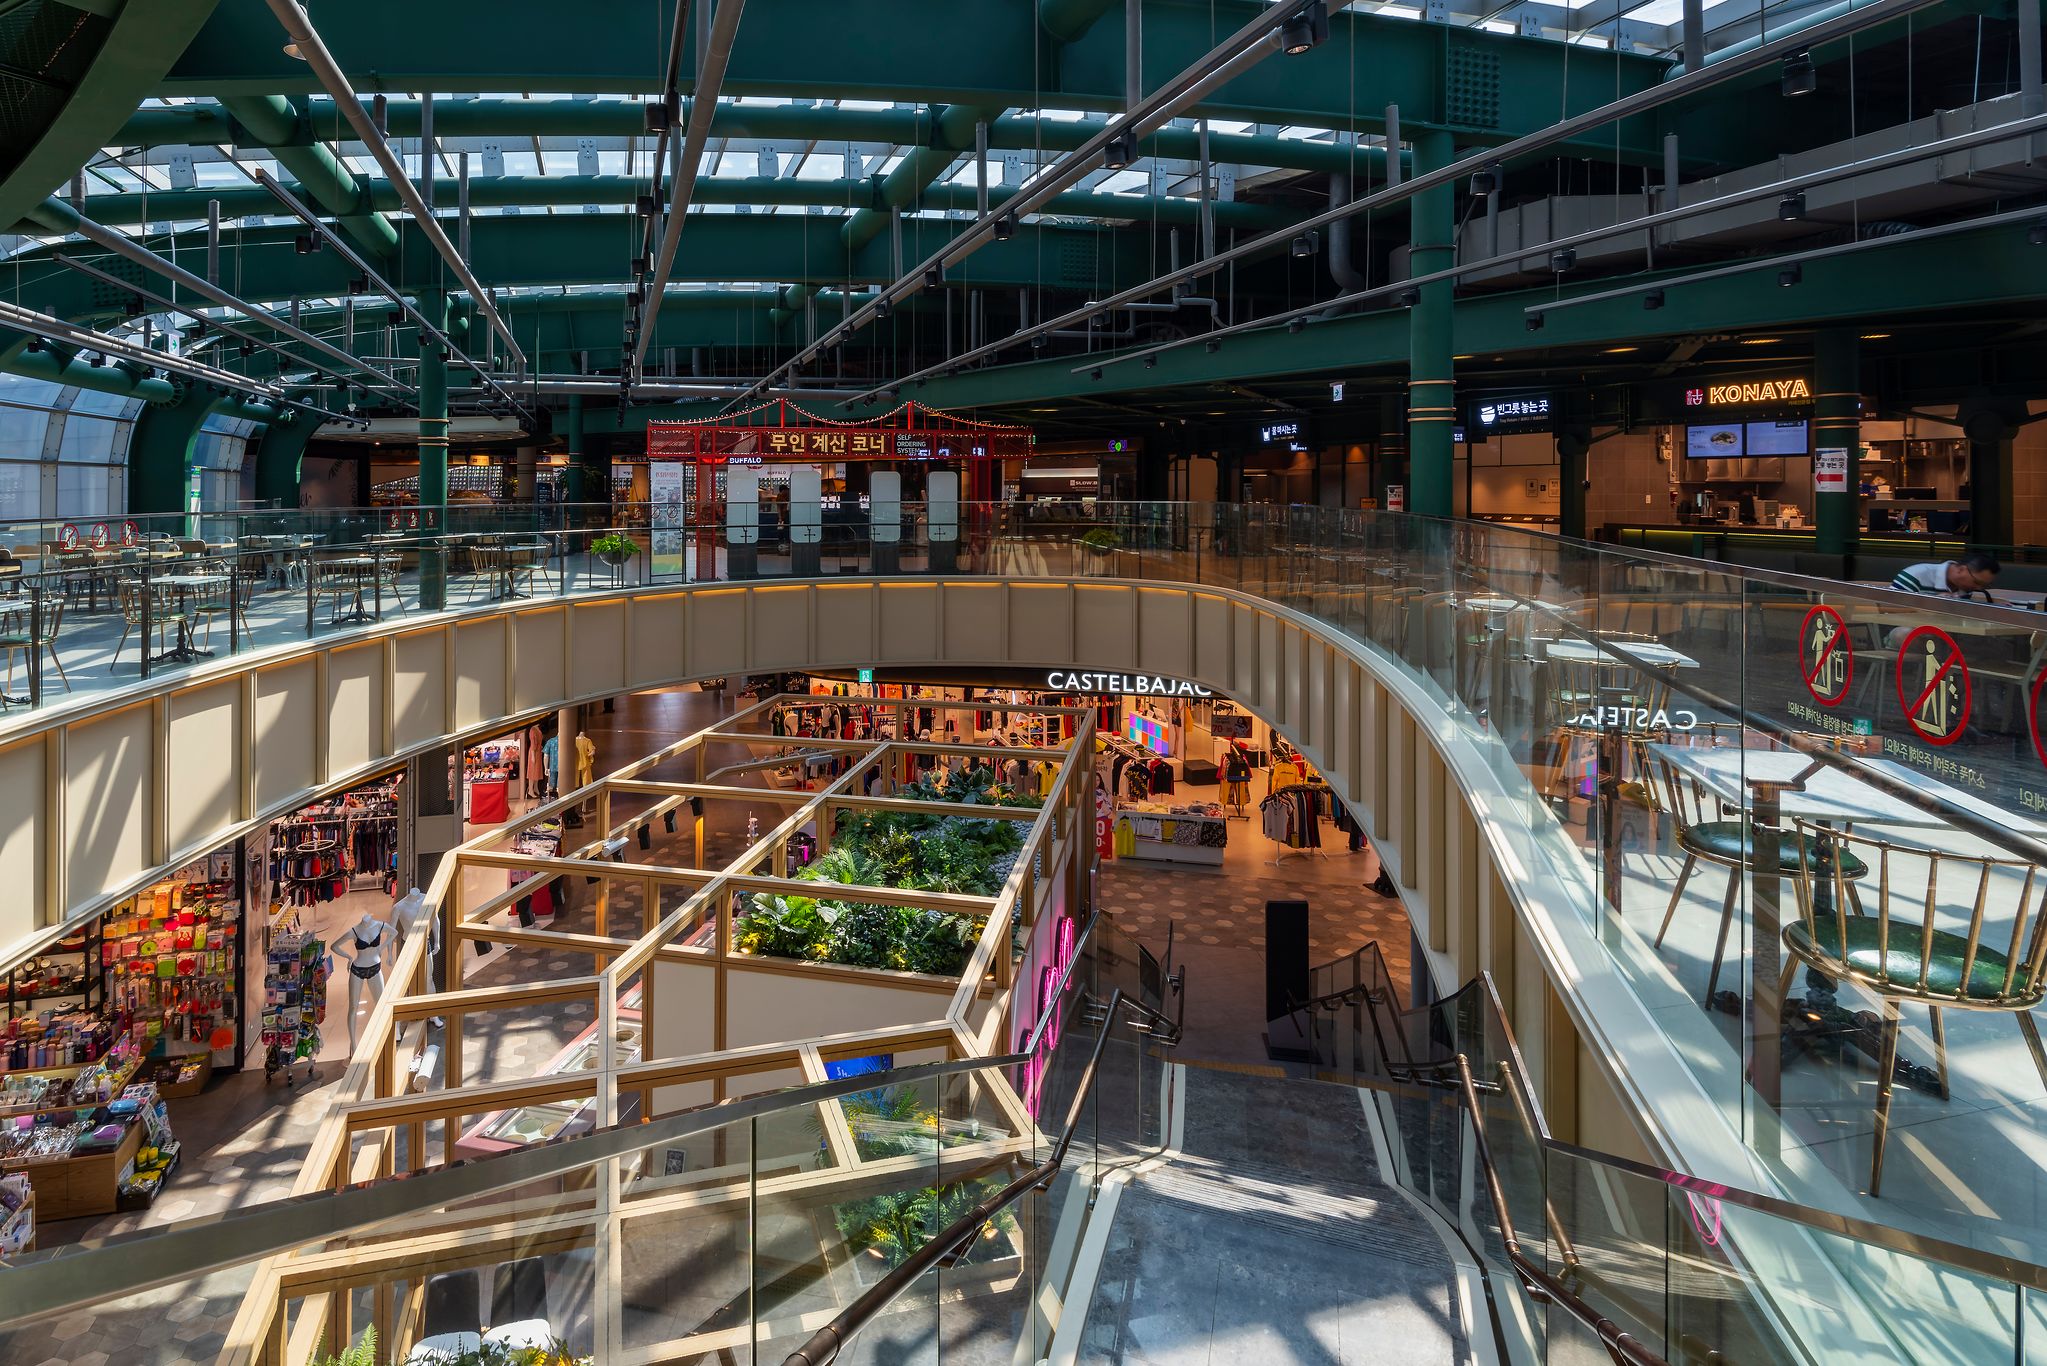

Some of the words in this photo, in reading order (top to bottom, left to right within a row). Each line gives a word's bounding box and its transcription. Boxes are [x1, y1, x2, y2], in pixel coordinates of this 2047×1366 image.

[1709, 379, 1809, 404] KONAYA
[1497, 402, 1520, 415] 빈그릇
[1521, 401, 1538, 414] 놓는
[1538, 399, 1549, 412] 곳
[769, 433, 805, 453] 무인
[811, 433, 847, 453] 계산
[851, 435, 885, 454] 코너
